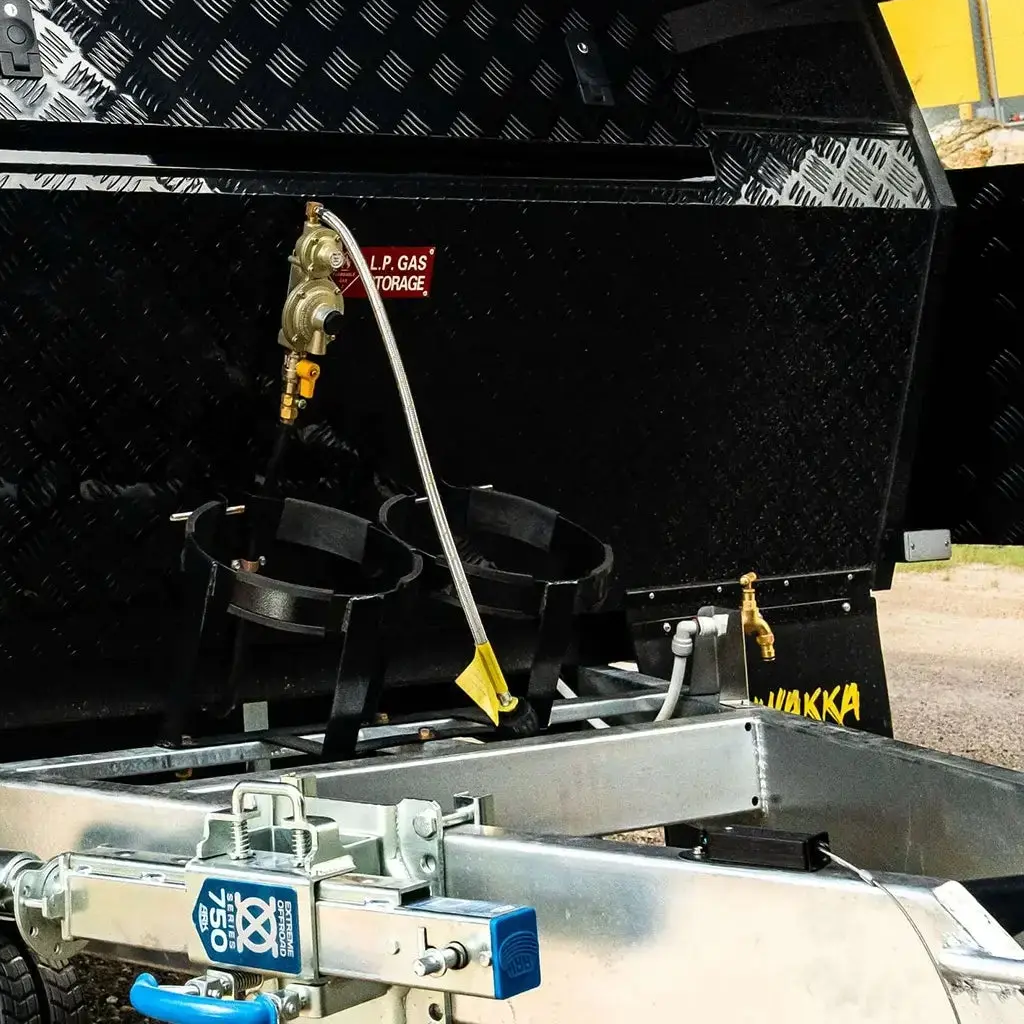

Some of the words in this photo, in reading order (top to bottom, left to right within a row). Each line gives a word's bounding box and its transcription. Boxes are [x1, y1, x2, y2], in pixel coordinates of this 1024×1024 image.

[370, 255, 394, 271] L.P.
[397, 254, 428, 271] GAS
[373, 275, 426, 291] TORAGE
[208, 887, 228, 954] 750
[226, 892, 236, 950] SERIES
[277, 899, 287, 958] OFFROAD
[284, 900, 295, 958] EXTREME
